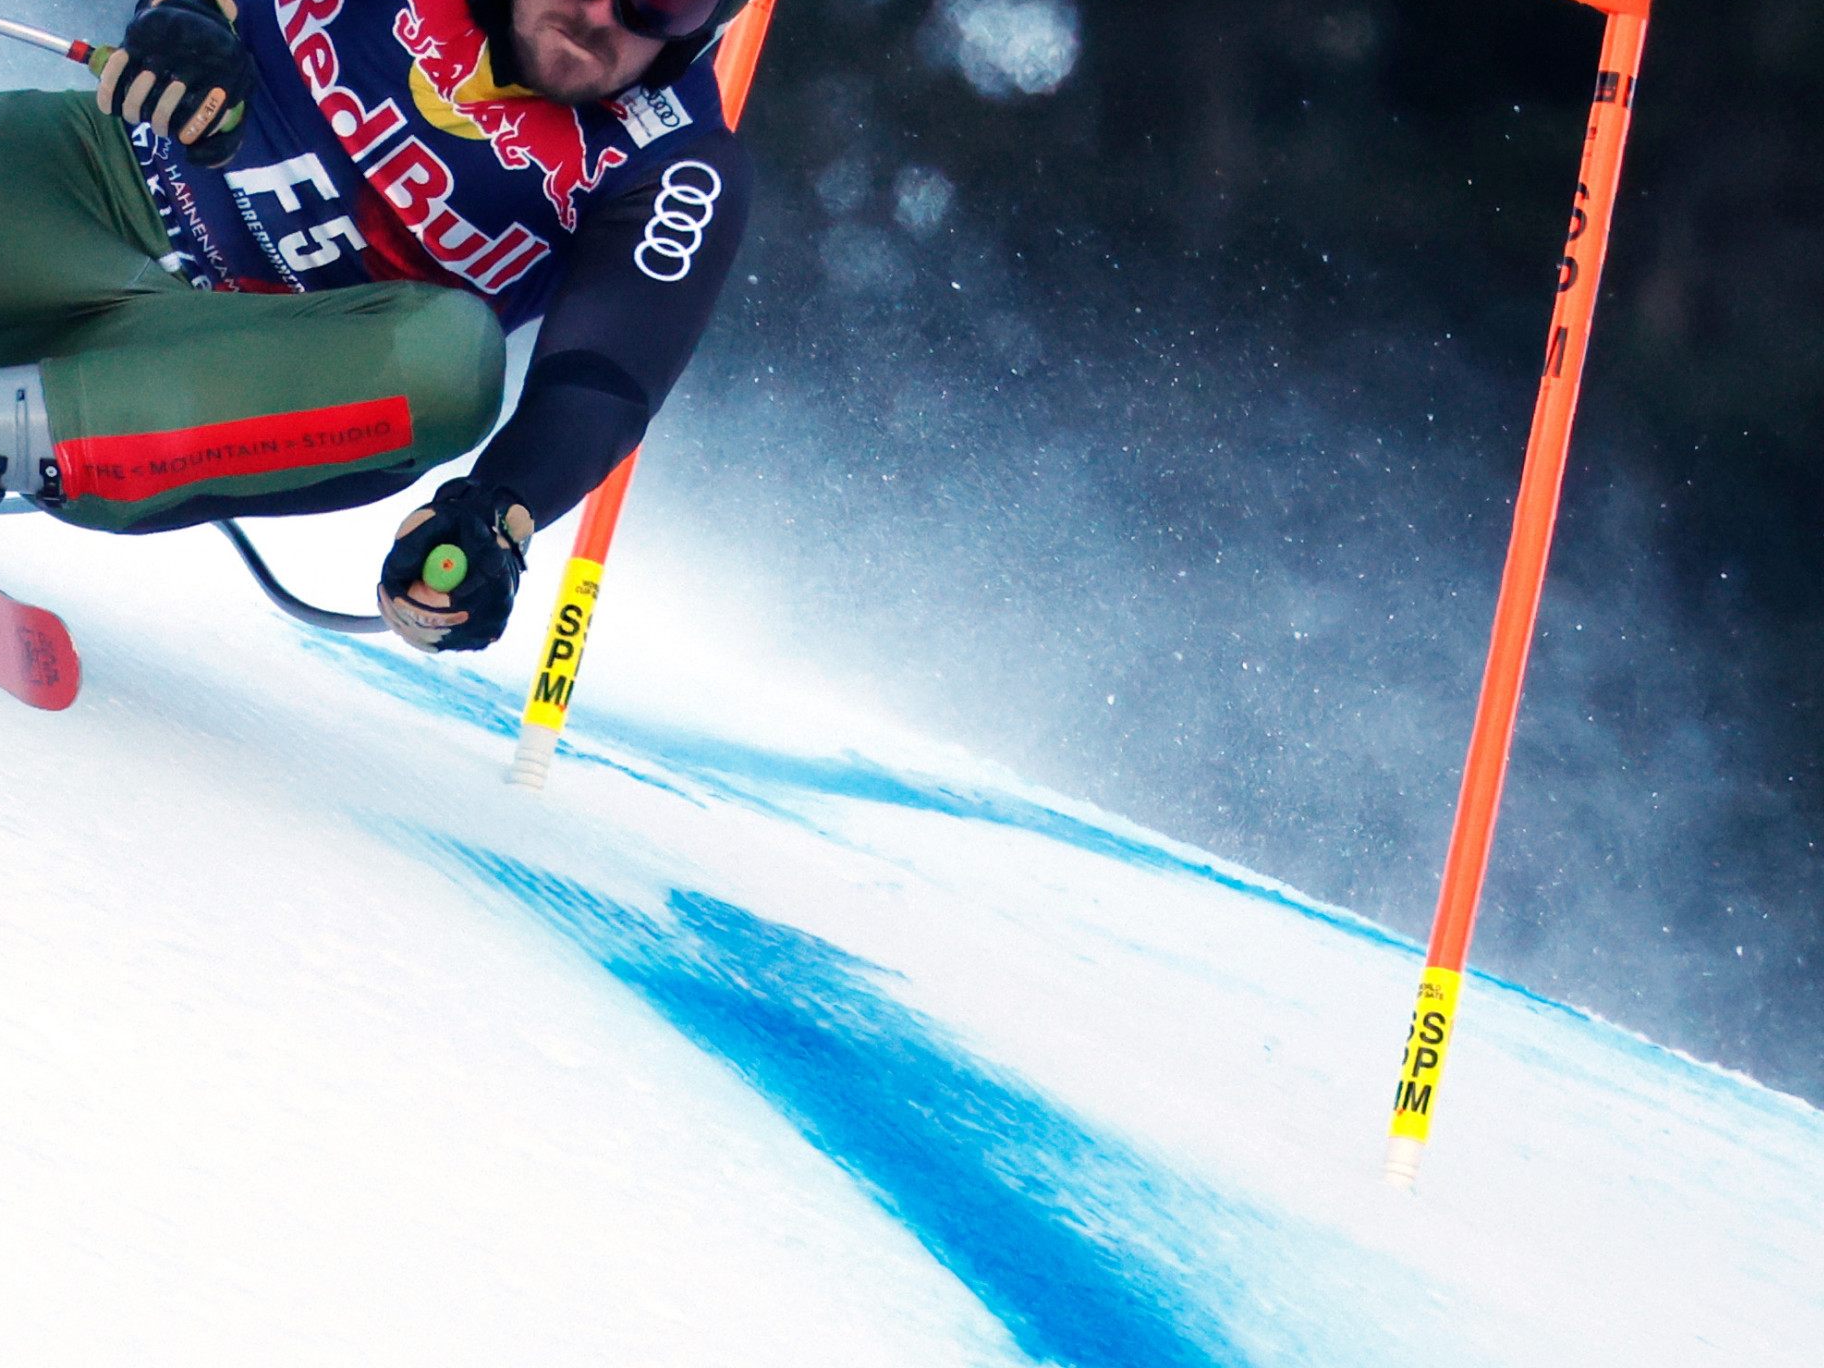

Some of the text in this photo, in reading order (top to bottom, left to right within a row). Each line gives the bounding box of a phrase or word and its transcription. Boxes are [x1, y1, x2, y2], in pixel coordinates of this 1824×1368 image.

[233, 187, 306, 293] ORERUNNER
[364, 134, 551, 294] Bull
[82, 420, 392, 481] THE MOUNTAIN STUDIO
